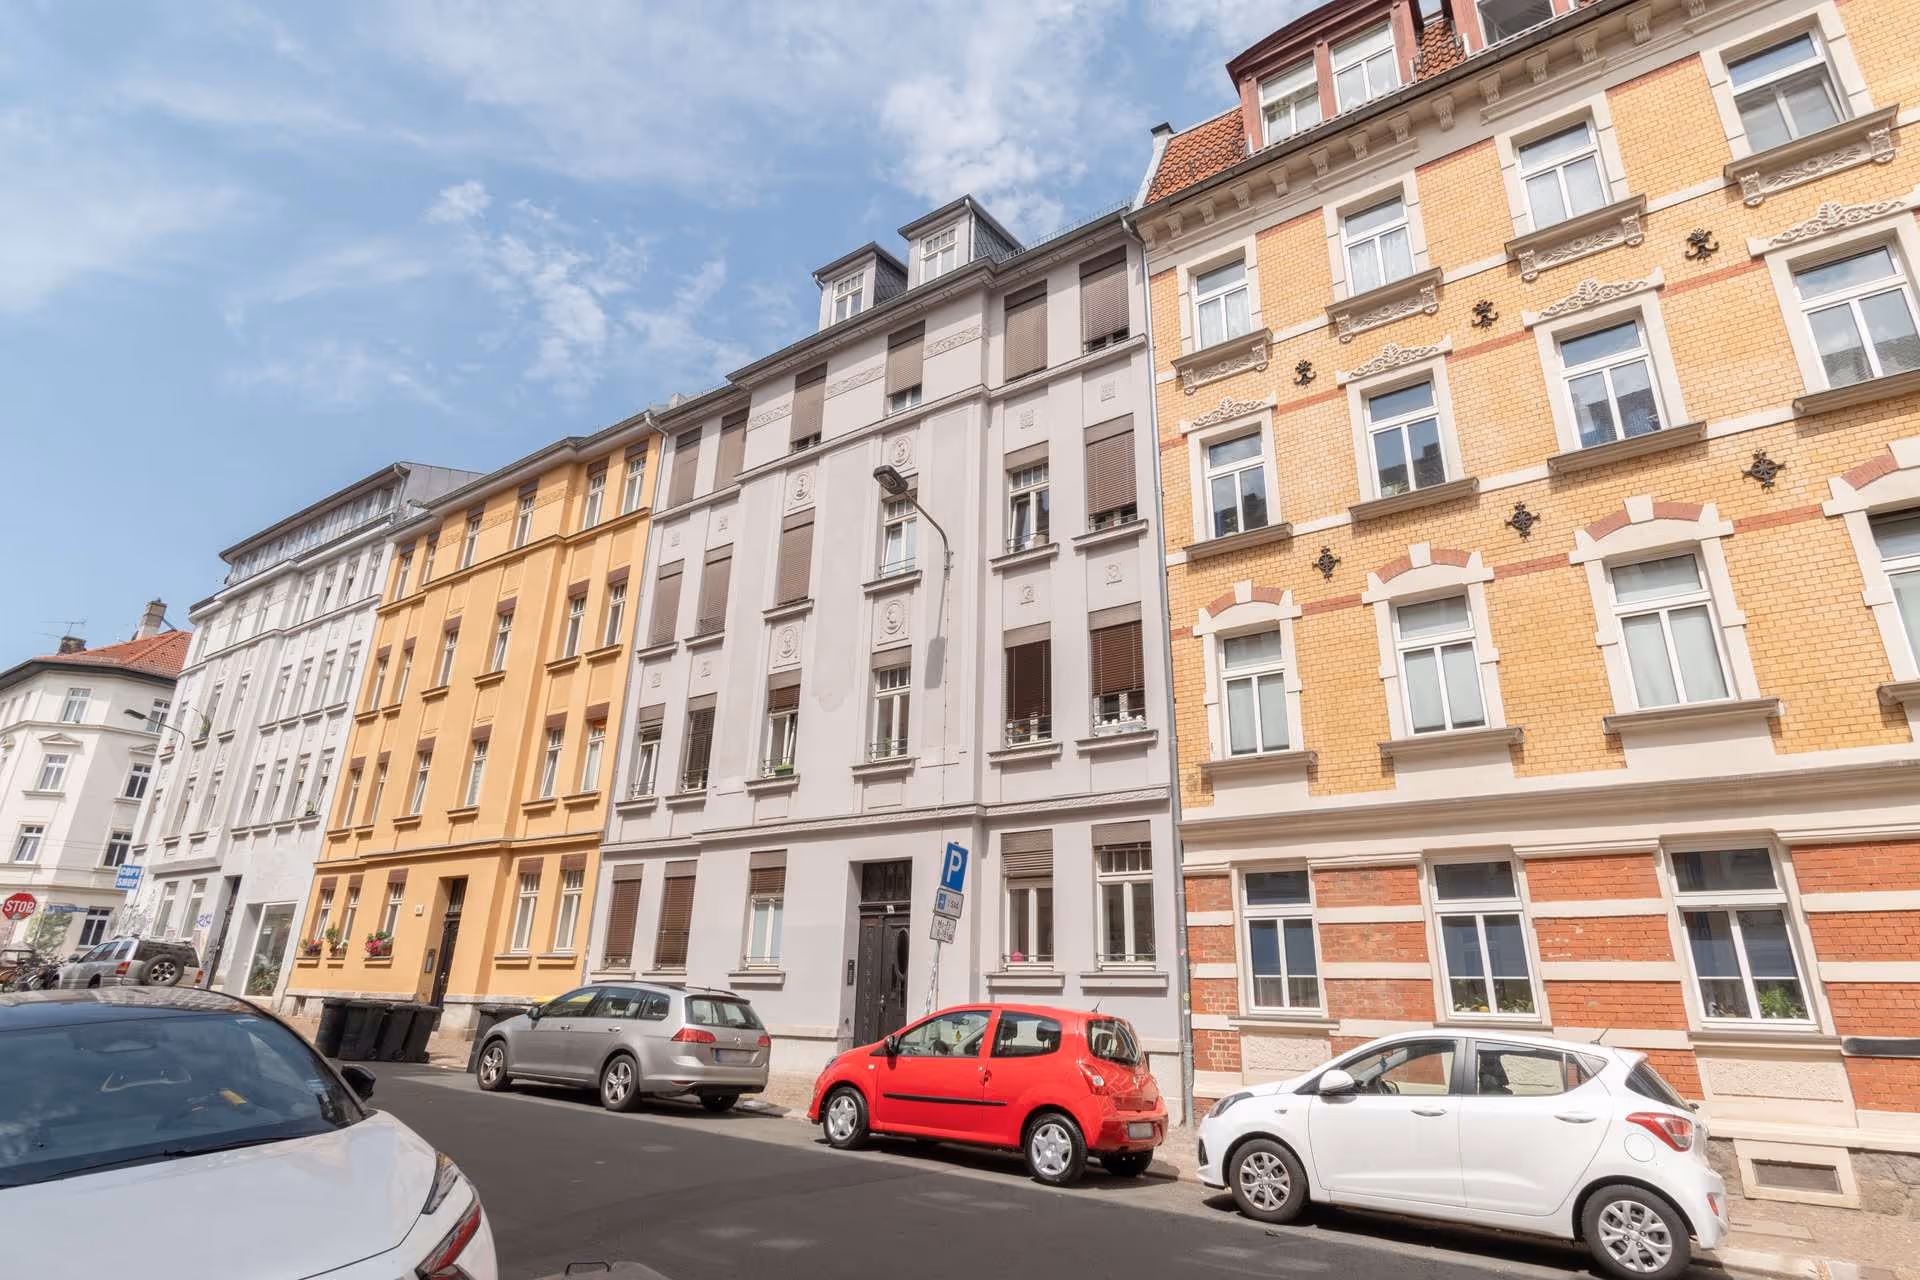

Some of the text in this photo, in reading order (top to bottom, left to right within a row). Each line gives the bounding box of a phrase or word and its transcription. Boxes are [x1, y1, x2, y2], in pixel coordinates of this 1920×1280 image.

[120, 867, 139, 877] COPY
[947, 850, 962, 883] P
[117, 878, 137, 887] SHOP
[4, 900, 35, 914] STOP
